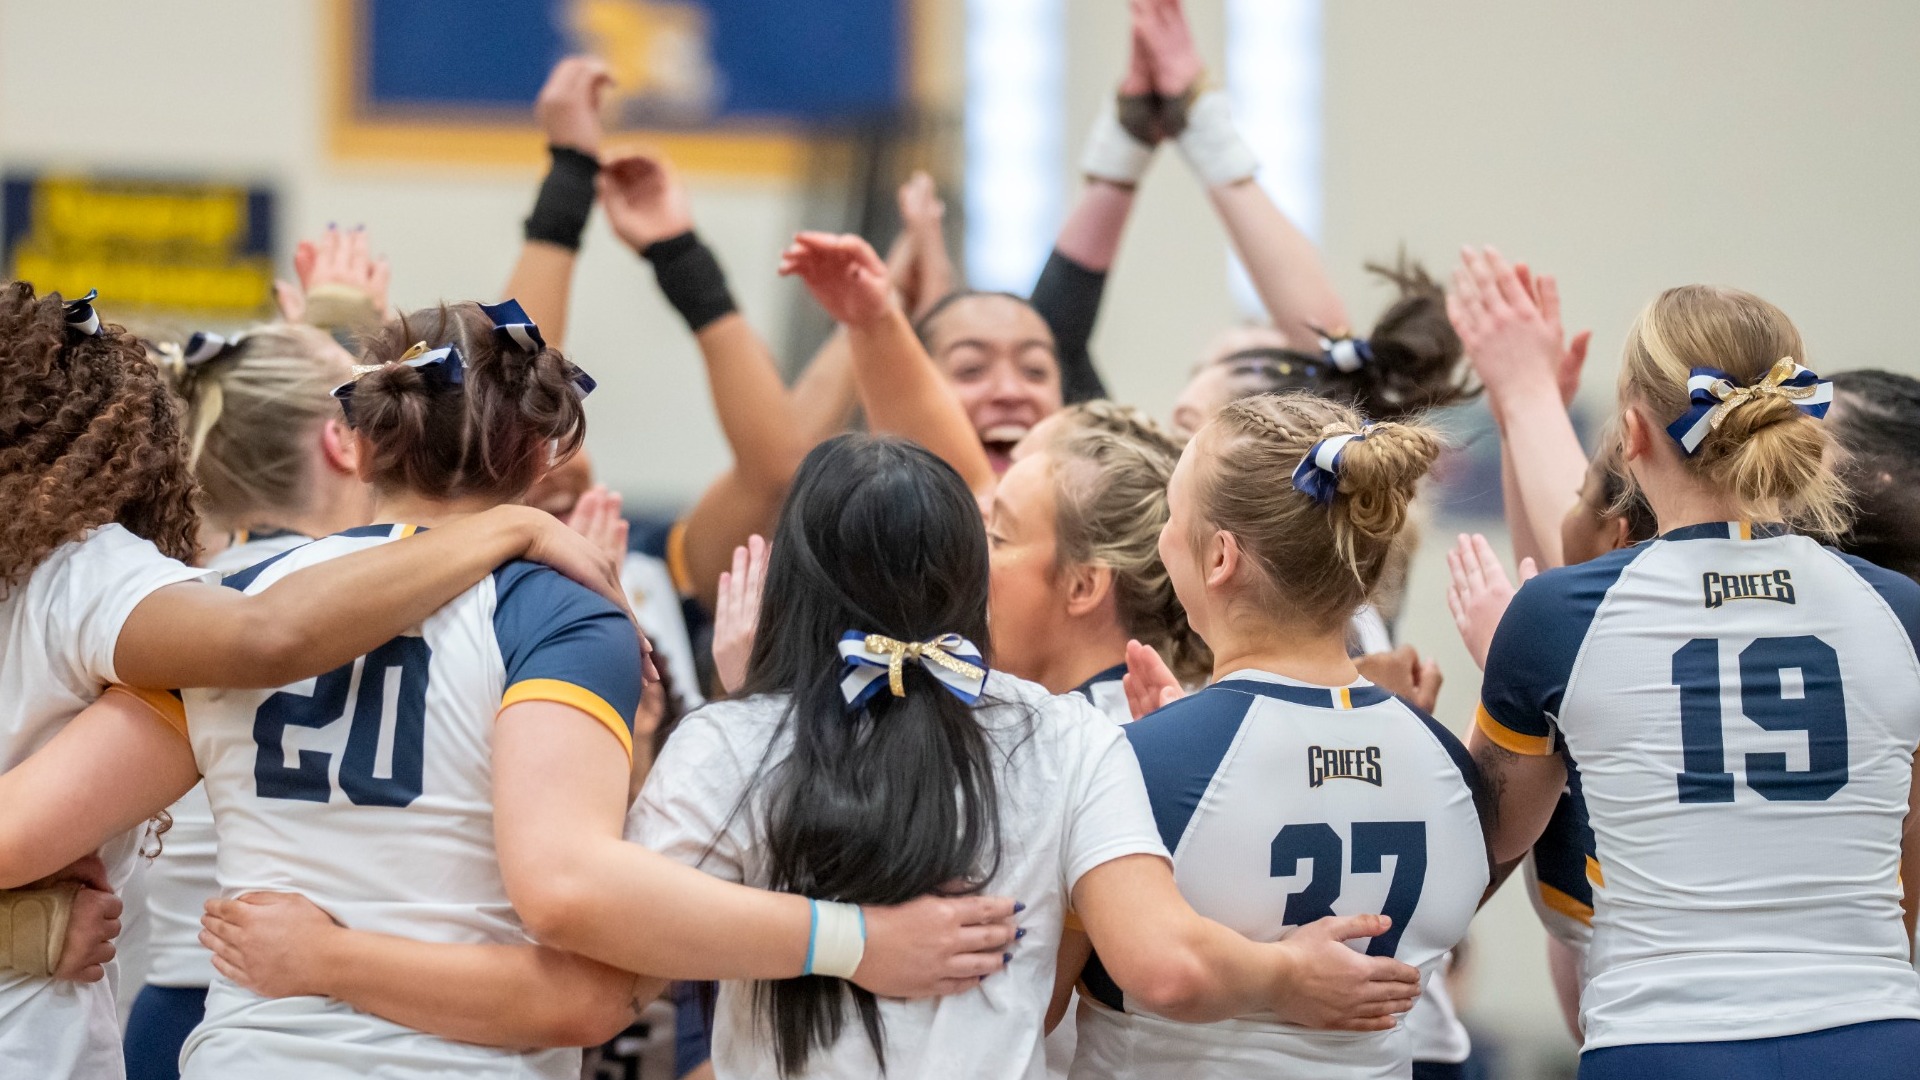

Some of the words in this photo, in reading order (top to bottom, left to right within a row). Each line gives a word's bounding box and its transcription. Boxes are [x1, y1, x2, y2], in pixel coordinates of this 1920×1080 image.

[1703, 569, 1796, 609] GRIFFS
[253, 636, 432, 808] 20
[1307, 745, 1382, 788] GRIFFS
[1671, 634, 1849, 804] 19
[1270, 821, 1427, 958] 37
